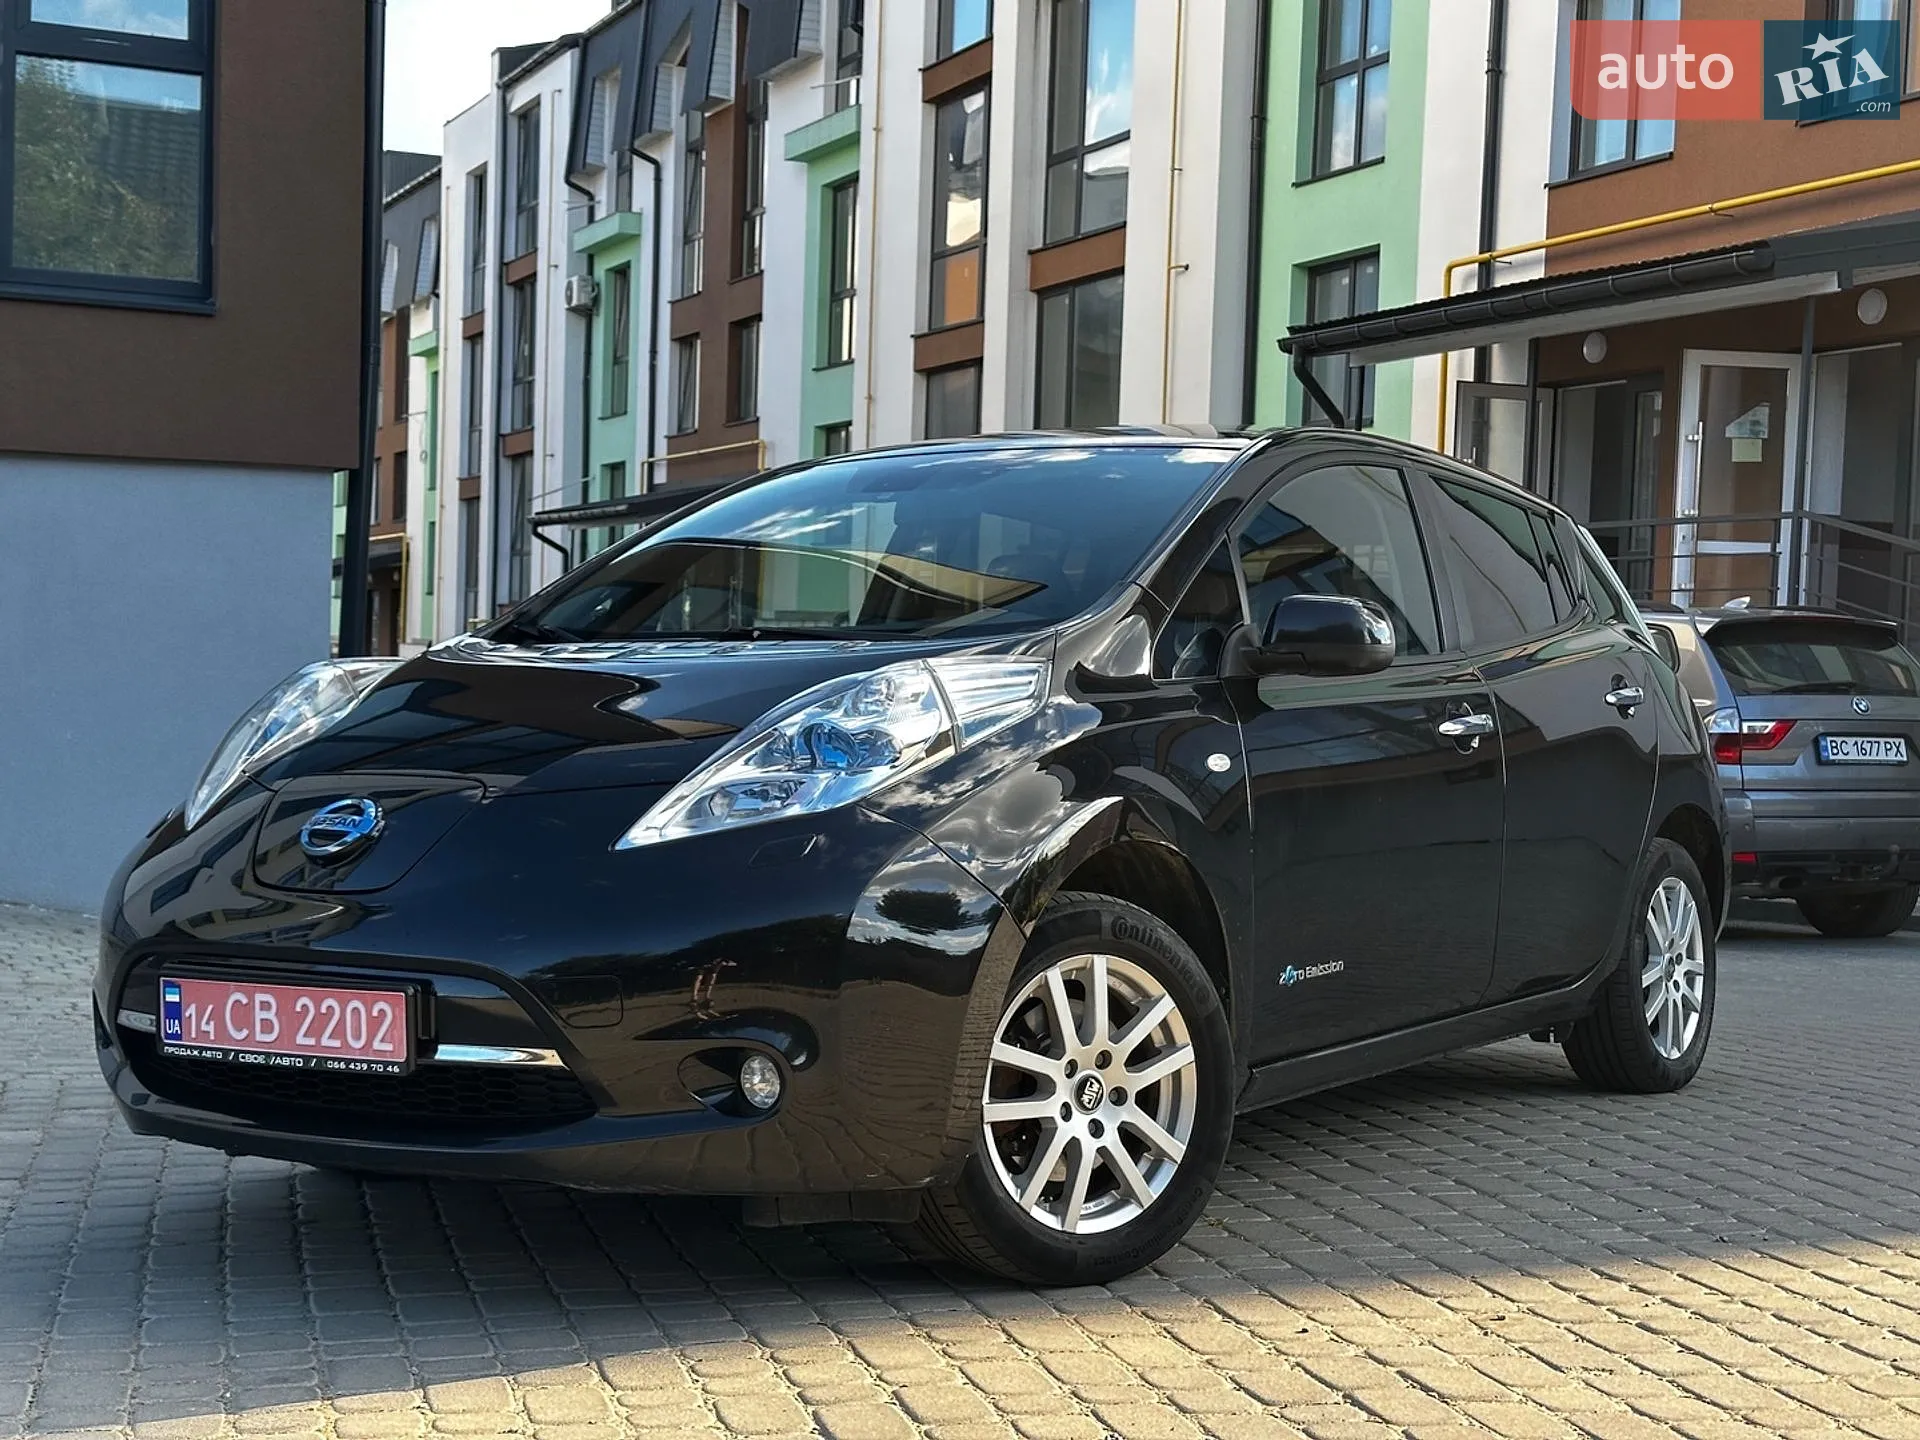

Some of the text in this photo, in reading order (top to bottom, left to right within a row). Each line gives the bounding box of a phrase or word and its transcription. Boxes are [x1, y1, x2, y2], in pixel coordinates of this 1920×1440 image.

[1829, 740, 1849, 756] BC
[1852, 740, 1880, 757] 1677
[1884, 741, 1904, 758] PX
[1305, 959, 1344, 978] Emission
[165, 1018, 181, 1035] UA
[185, 991, 394, 1052] 14 CB 2202
[163, 1046, 200, 1057] ПРОДАЖ
[201, 1050, 223, 1059] АВТО
[326, 1060, 346, 1069] 066
[348, 1062, 367, 1071] 439
[370, 1064, 384, 1072] 70
[386, 1065, 400, 1073] 46
